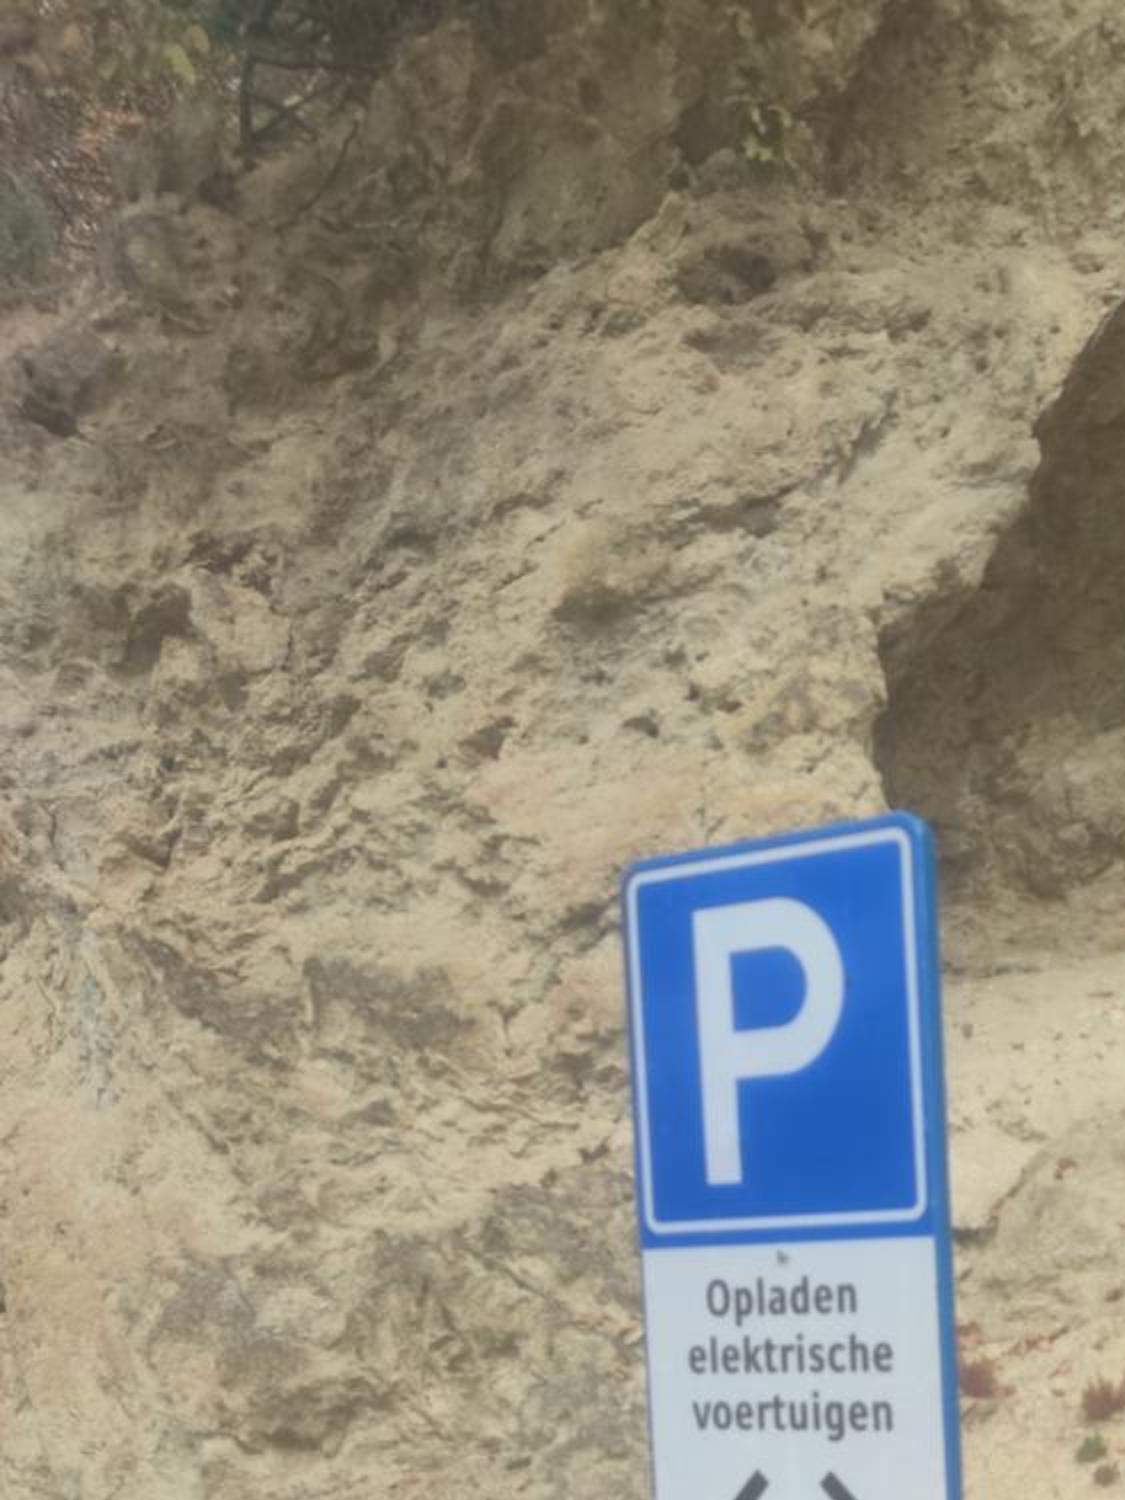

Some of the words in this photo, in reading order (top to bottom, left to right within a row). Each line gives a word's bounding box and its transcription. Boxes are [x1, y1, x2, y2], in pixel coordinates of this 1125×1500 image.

[692, 896, 845, 1185] P
[706, 1275, 857, 1327] Opladen
[688, 1333, 893, 1374] elektrische
[692, 1391, 893, 1442] voertuigen
